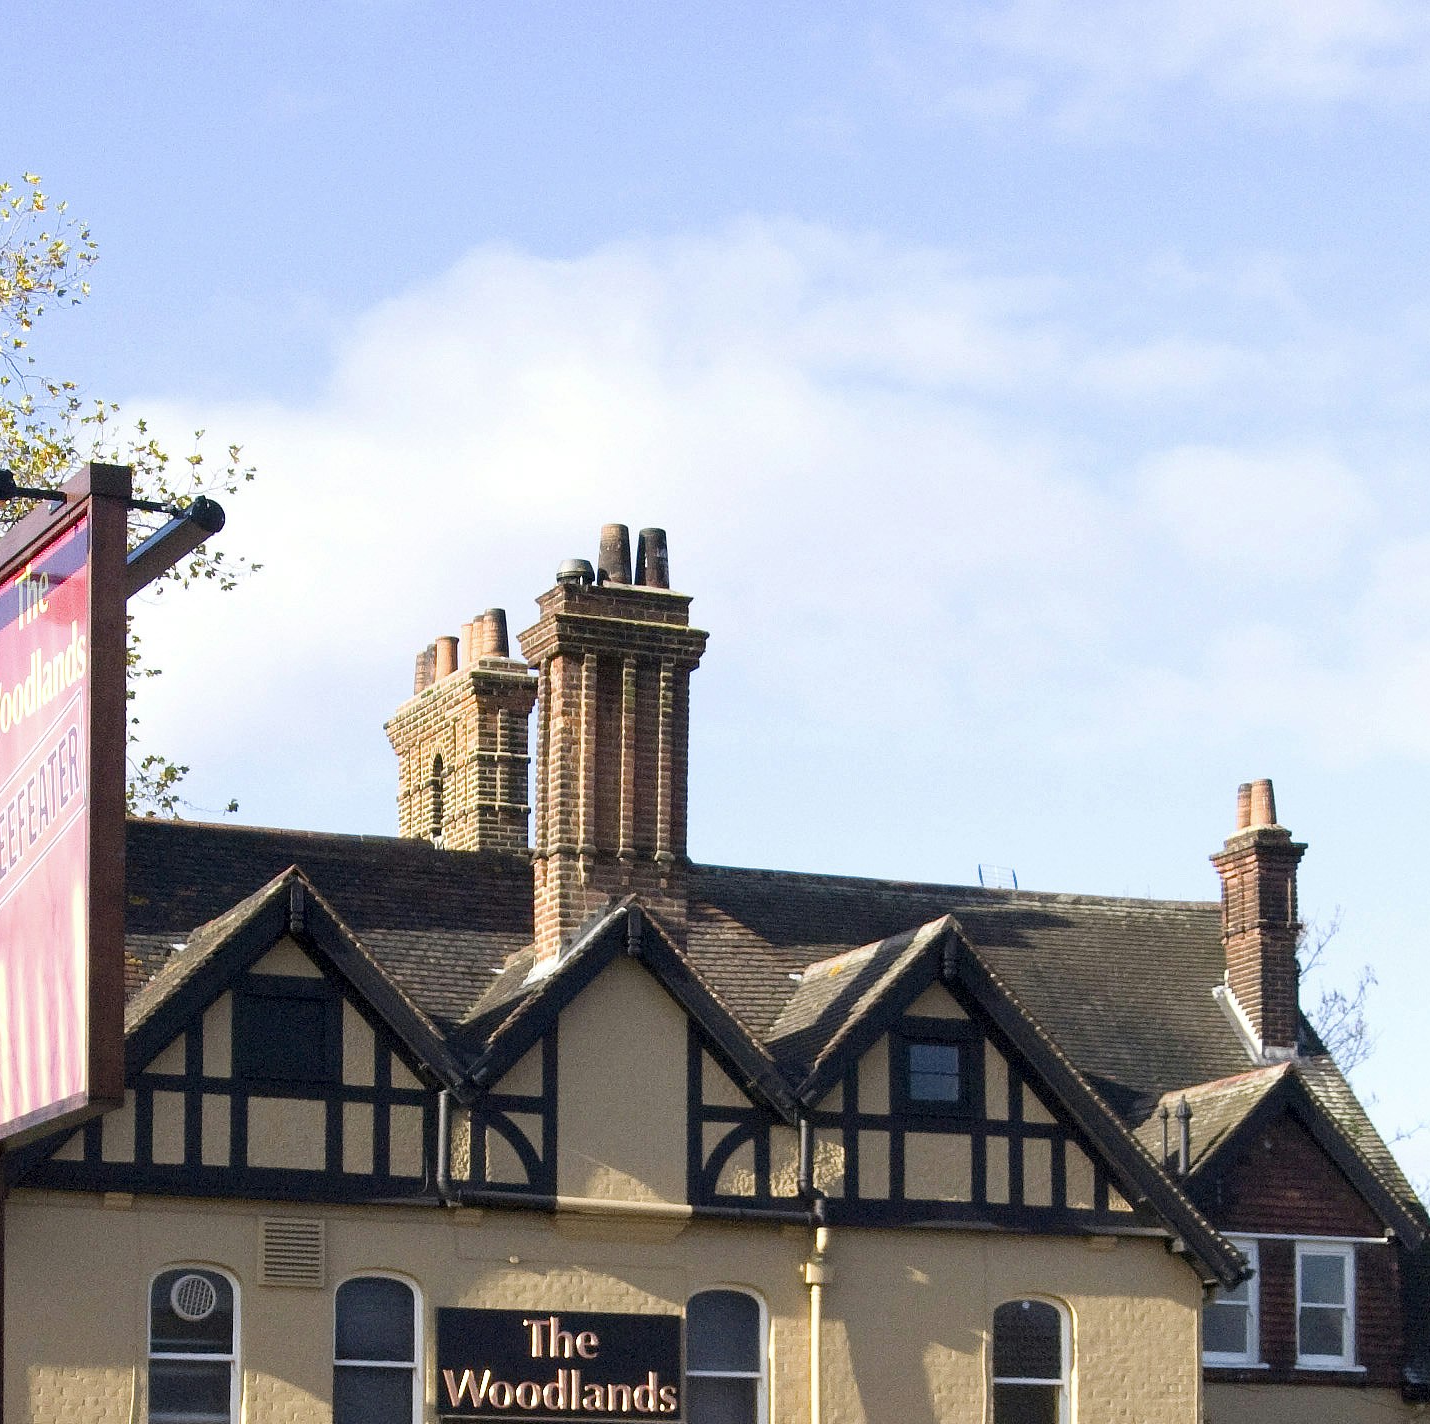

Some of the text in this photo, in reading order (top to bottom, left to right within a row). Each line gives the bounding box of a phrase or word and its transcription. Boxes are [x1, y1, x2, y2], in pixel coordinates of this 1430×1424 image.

[14, 562, 50, 631] The
[522, 1315, 600, 1360] The
[442, 1367, 678, 1413] Woodlands
